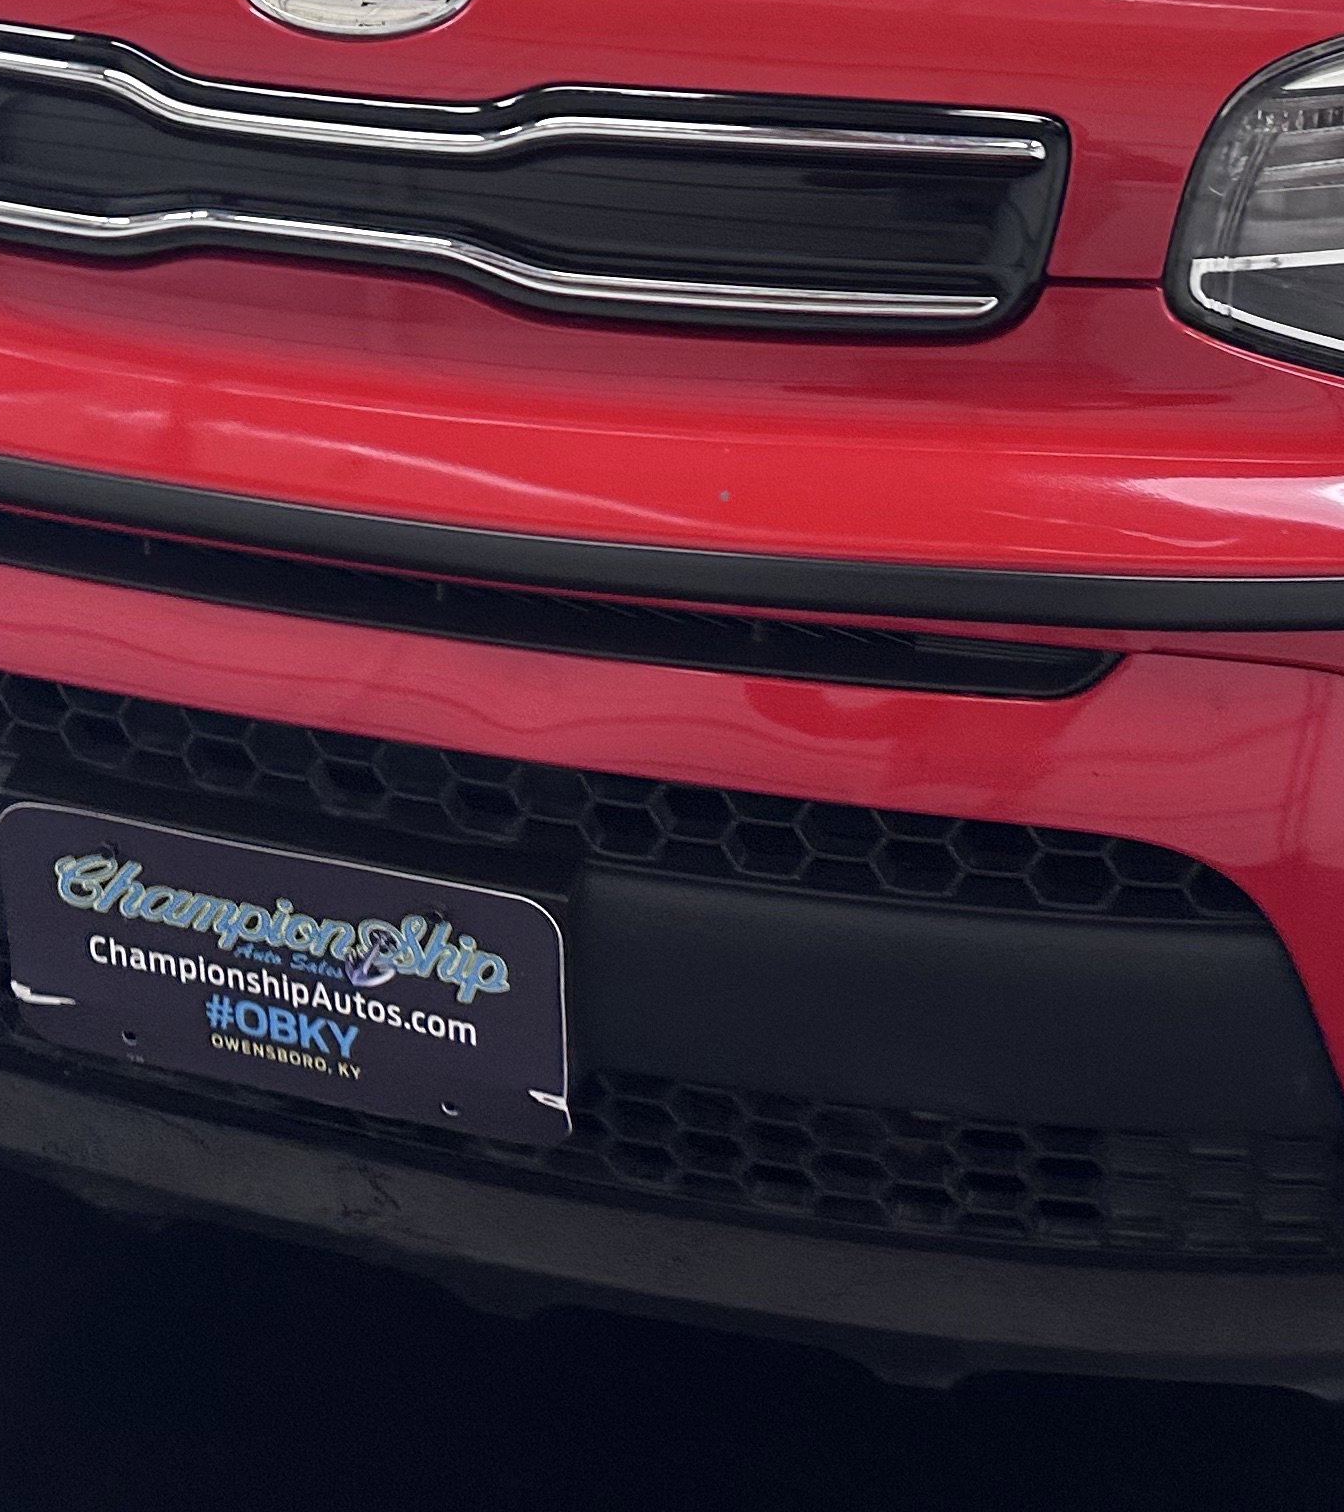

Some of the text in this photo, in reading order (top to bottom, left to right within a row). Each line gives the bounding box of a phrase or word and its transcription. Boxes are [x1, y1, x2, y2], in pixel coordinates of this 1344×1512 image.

[89, 935, 478, 1046] ChampionshipAutos.com
[206, 994, 359, 1059] #OBKY
[211, 1033, 361, 1080] OWENSBORO, KY
